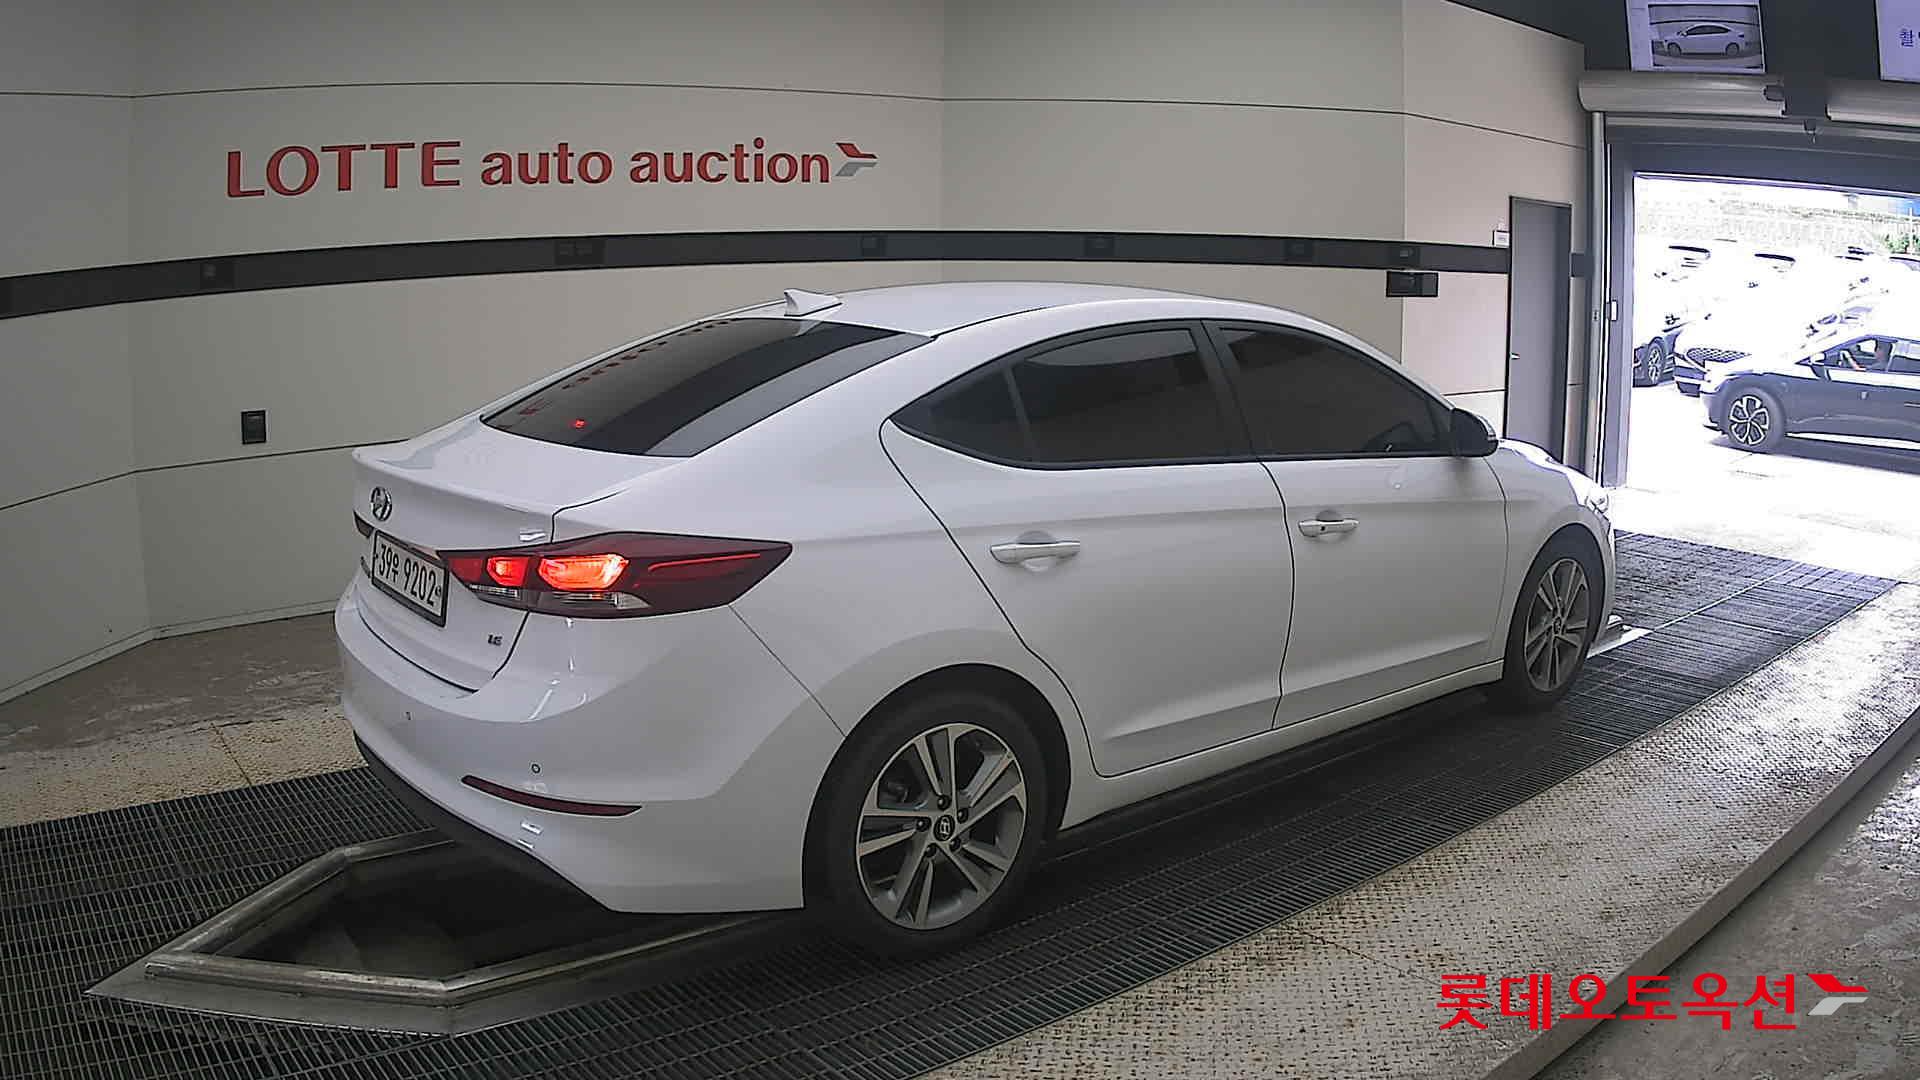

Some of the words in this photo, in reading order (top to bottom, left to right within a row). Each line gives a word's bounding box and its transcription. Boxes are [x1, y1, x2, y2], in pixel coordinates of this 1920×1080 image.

[227, 141, 461, 197] LOTTE
[480, 143, 613, 185] auto
[629, 138, 830, 184] auction
[403, 557, 436, 607] 9202
